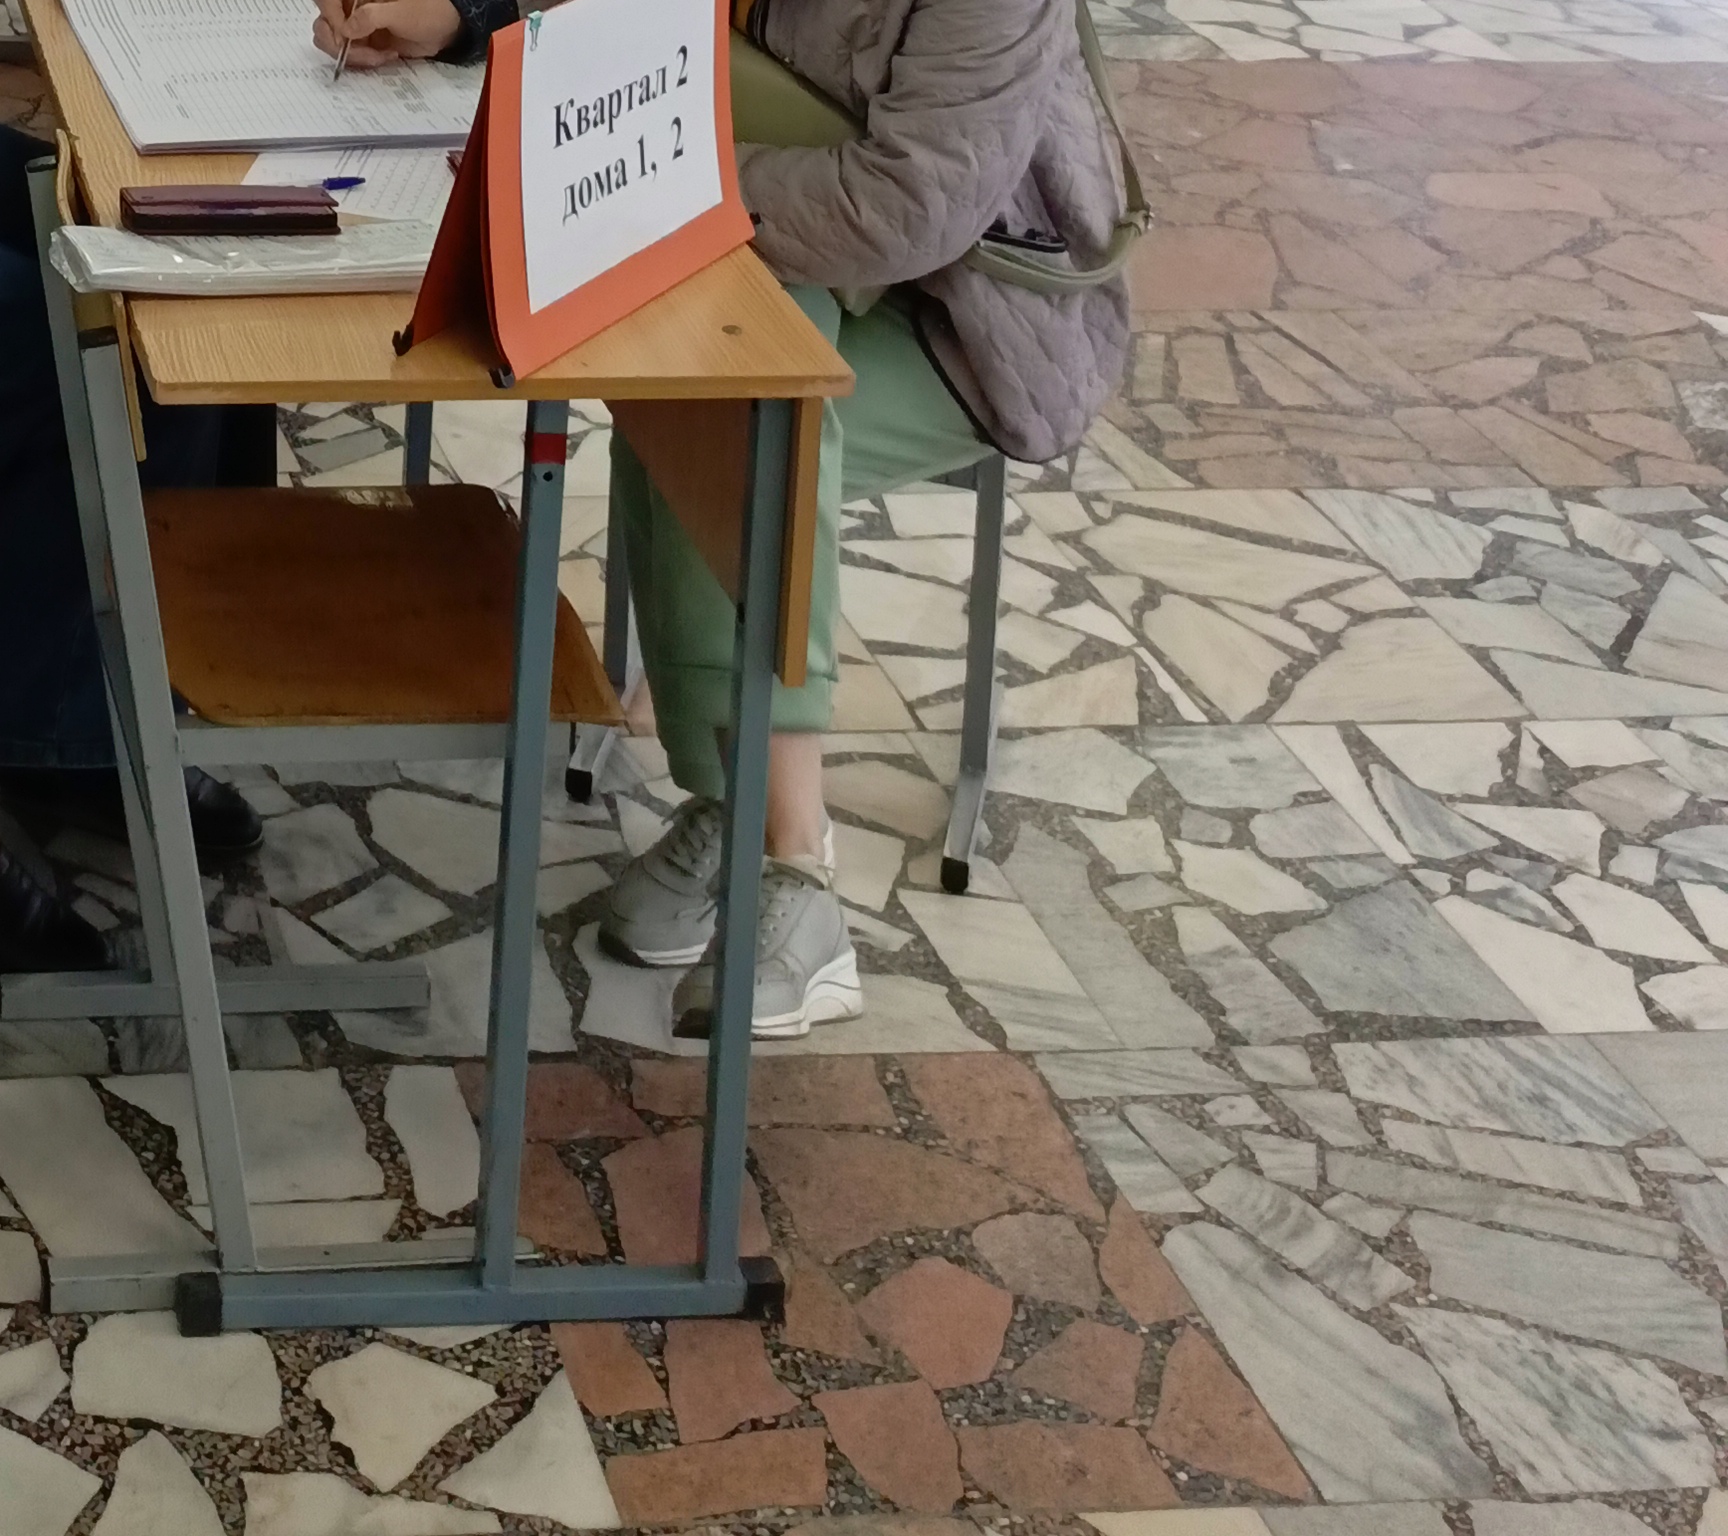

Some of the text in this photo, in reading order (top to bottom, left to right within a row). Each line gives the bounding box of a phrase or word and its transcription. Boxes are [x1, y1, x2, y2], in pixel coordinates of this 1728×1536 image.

[552, 44, 689, 150] Квартал 2
[562, 116, 684, 227] дома 1, 2
